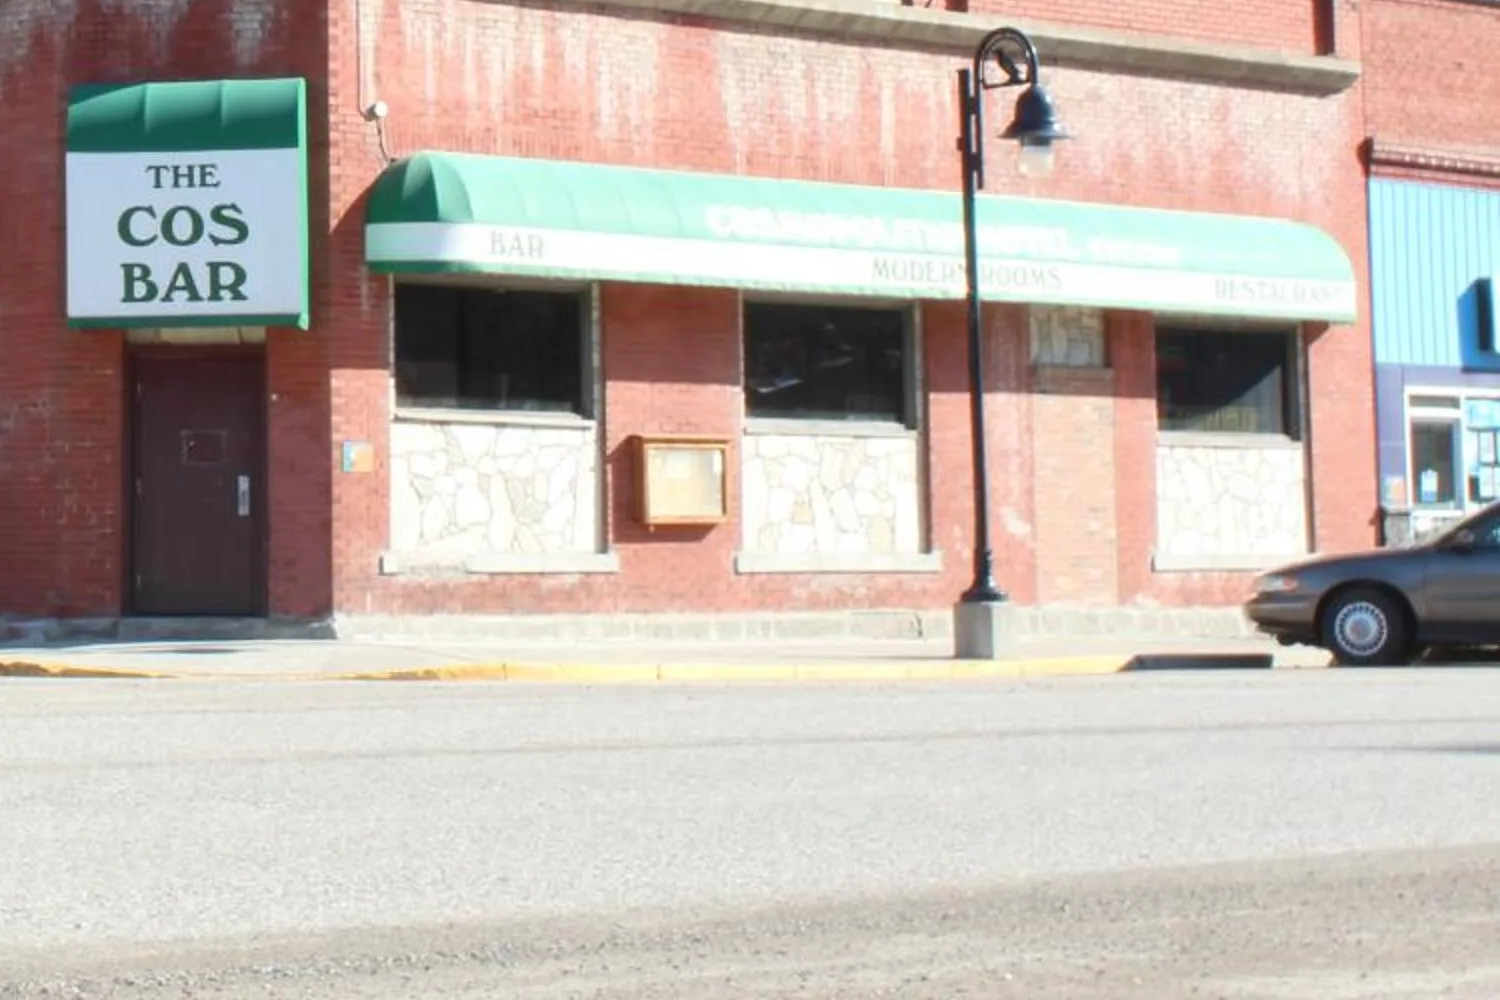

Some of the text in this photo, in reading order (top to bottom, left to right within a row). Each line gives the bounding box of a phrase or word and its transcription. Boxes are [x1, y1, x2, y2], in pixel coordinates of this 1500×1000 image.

[145, 163, 221, 189] THE
[116, 202, 249, 247] COS
[490, 230, 544, 258] BAR
[120, 261, 248, 303] BAR
[979, 262, 1062, 290] ROOMS
